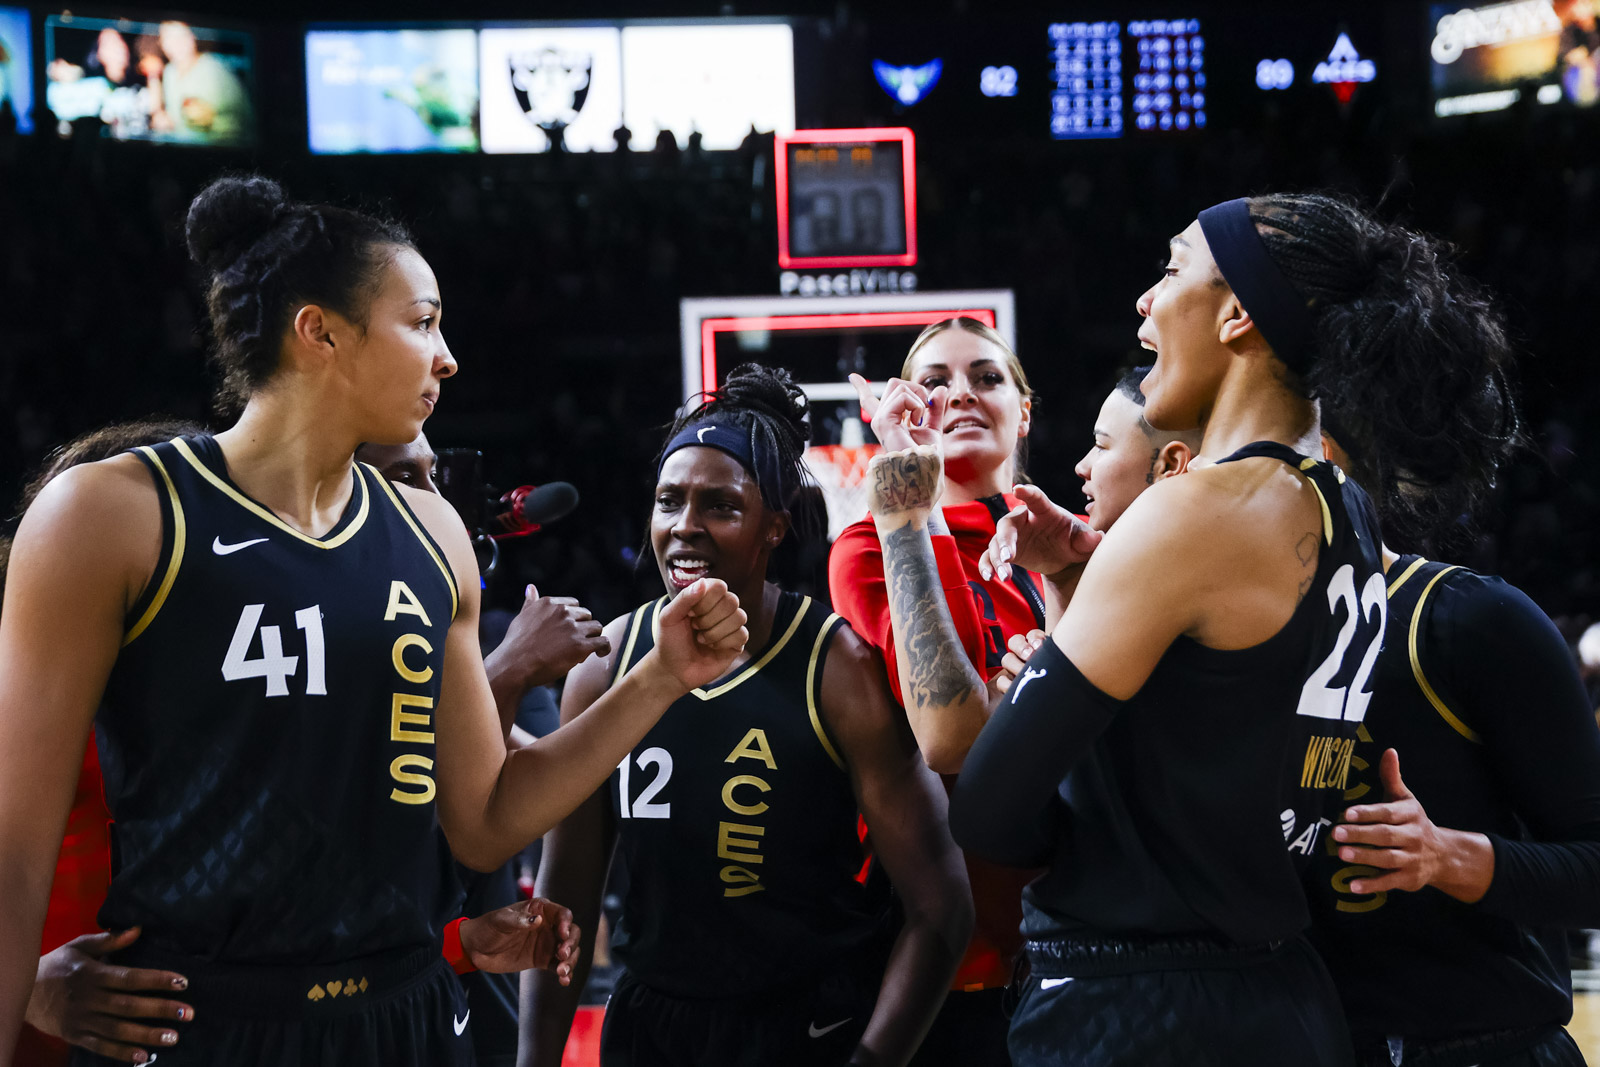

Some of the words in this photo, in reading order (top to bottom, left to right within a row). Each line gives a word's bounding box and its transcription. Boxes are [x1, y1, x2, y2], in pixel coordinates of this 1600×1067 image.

[221, 604, 327, 697] 41
[384, 580, 436, 805] ACES
[1296, 564, 1388, 722] 22
[616, 747, 673, 819] 12
[717, 728, 778, 897] ACES
